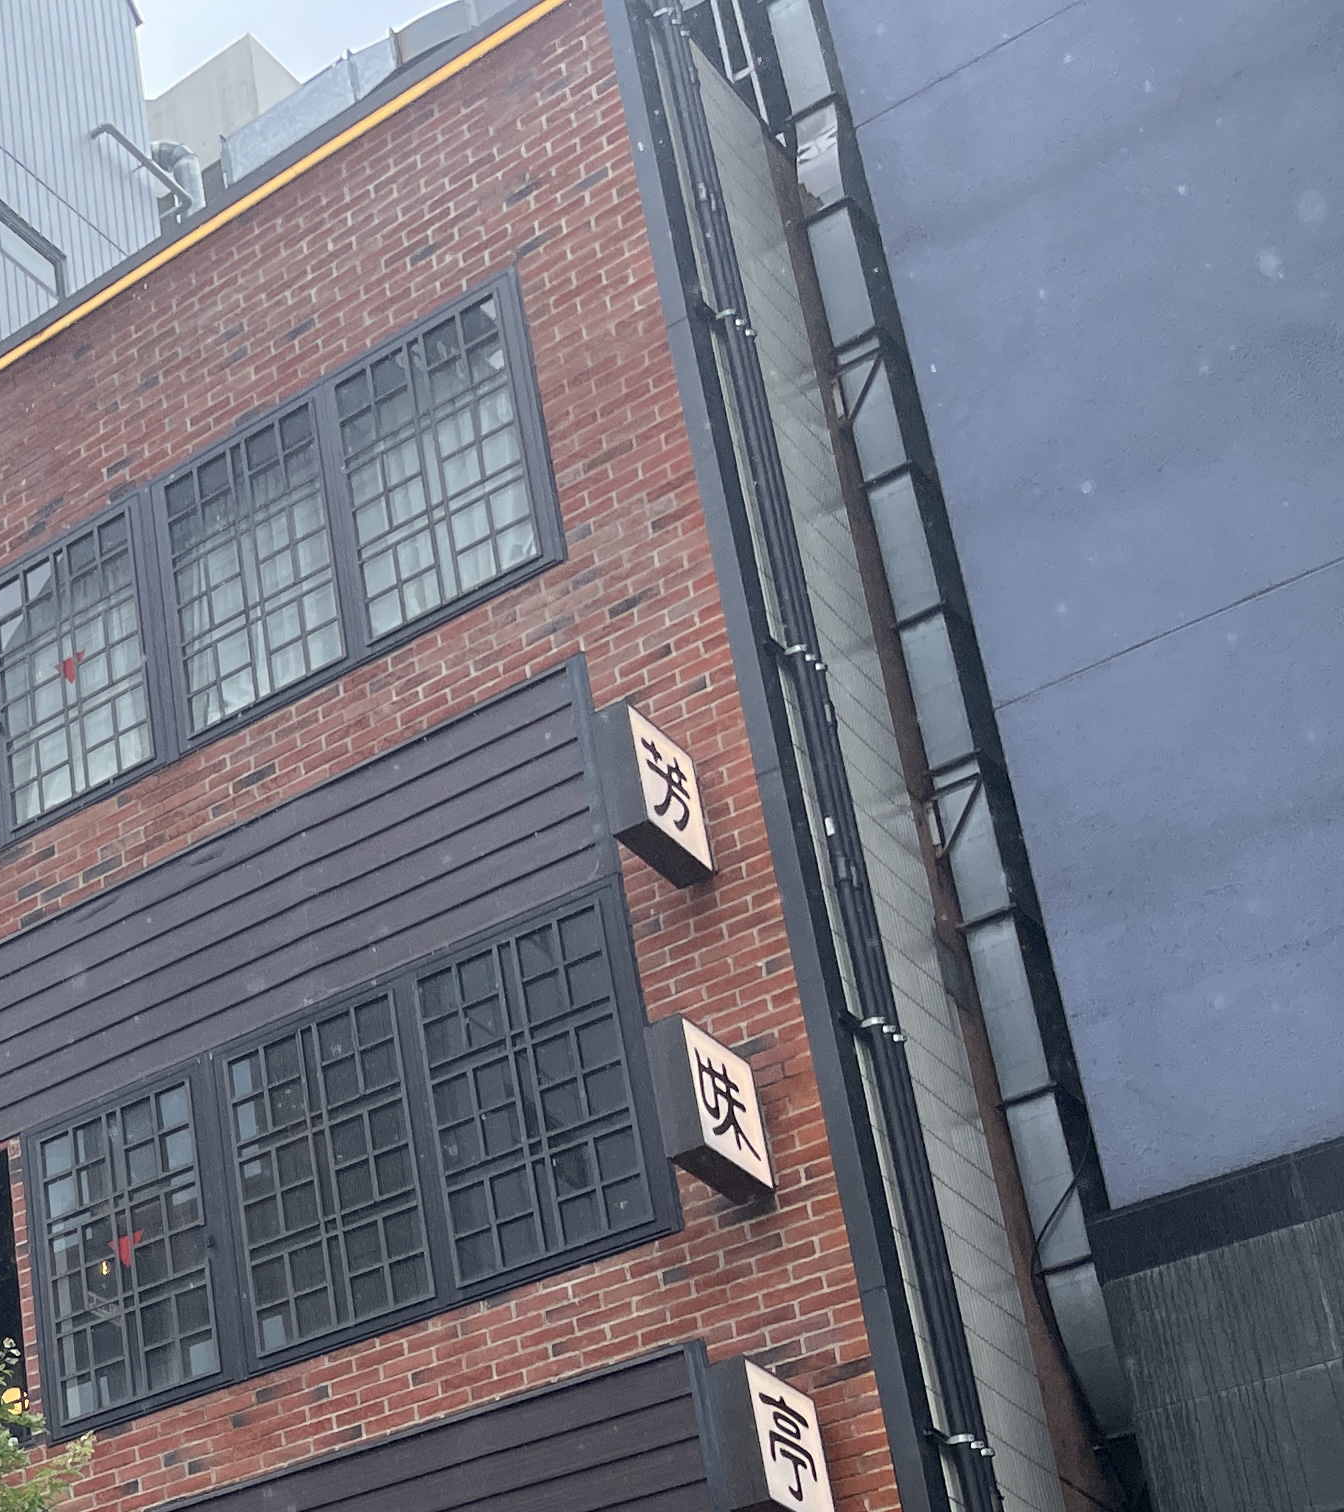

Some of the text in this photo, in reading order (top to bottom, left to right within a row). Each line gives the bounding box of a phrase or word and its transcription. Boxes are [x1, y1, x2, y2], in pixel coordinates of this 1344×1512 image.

[641, 737, 691, 831] 芳
[694, 1046, 762, 1160] 味
[758, 1392, 818, 1502] 亭
